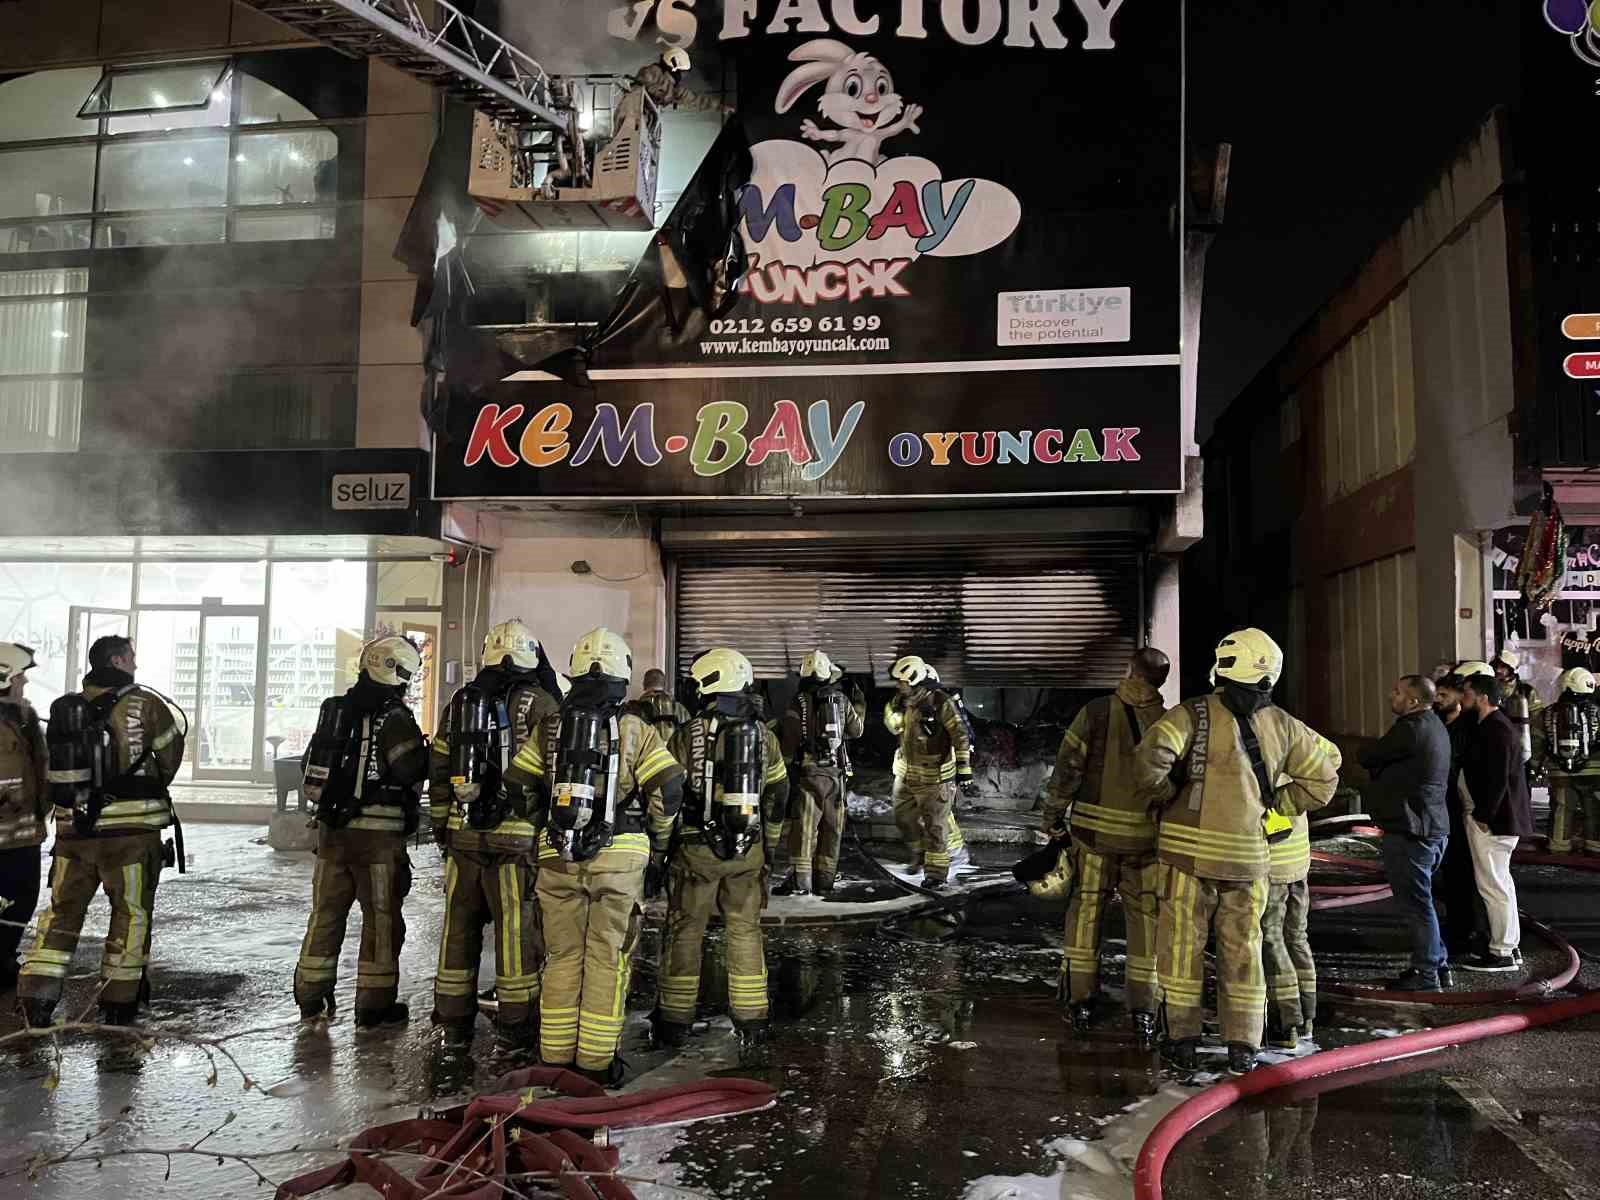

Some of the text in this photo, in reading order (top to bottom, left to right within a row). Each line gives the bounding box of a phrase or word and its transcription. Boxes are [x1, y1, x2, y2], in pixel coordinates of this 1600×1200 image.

[1007, 292, 1122, 315] Türkiye
[710, 315, 881, 335] 0212 659 61 99
[1009, 318, 1077, 329] Discover
[1009, 327, 1103, 341] the potential
[700, 335, 890, 356] www.kembayoyuncak.com
[888, 428, 1141, 467] OYUNCAK
[337, 477, 405, 502] seluz
[1191, 702, 1208, 780] ISTANBUL
